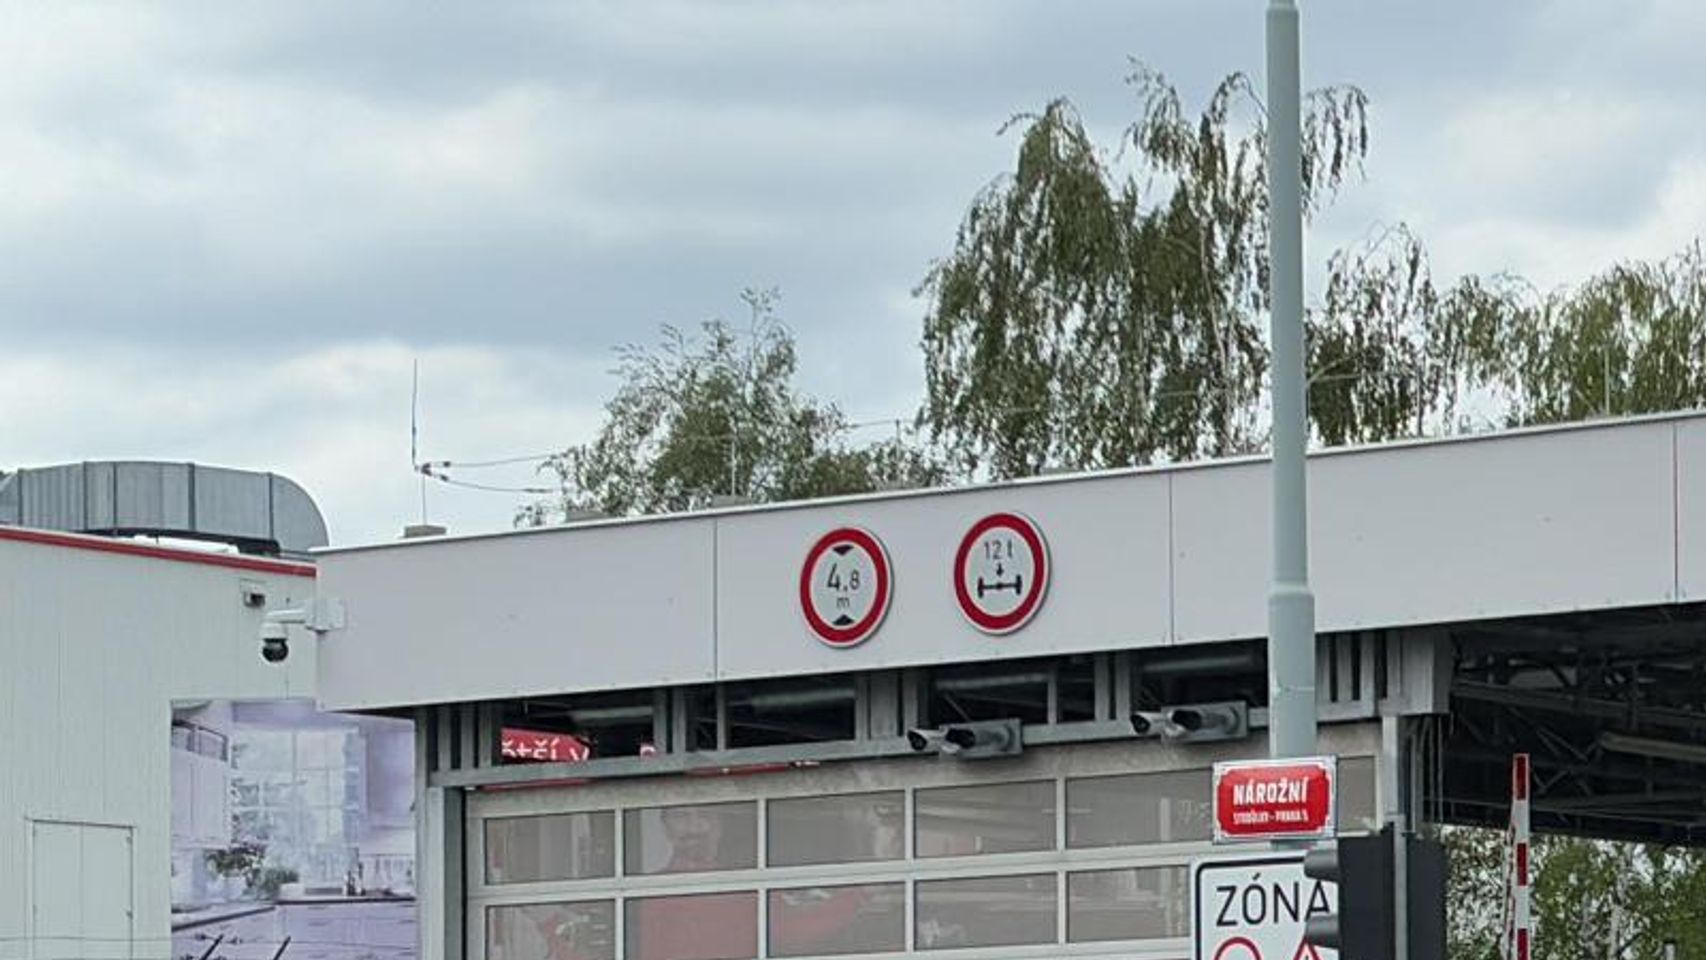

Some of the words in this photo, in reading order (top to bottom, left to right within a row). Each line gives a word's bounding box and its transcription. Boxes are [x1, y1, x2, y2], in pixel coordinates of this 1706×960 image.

[984, 540, 1002, 560] 12
[837, 597, 850, 609] m
[1233, 776, 1309, 805] NÁROŽNÍ
[1216, 872, 1330, 927] ZÓNA
